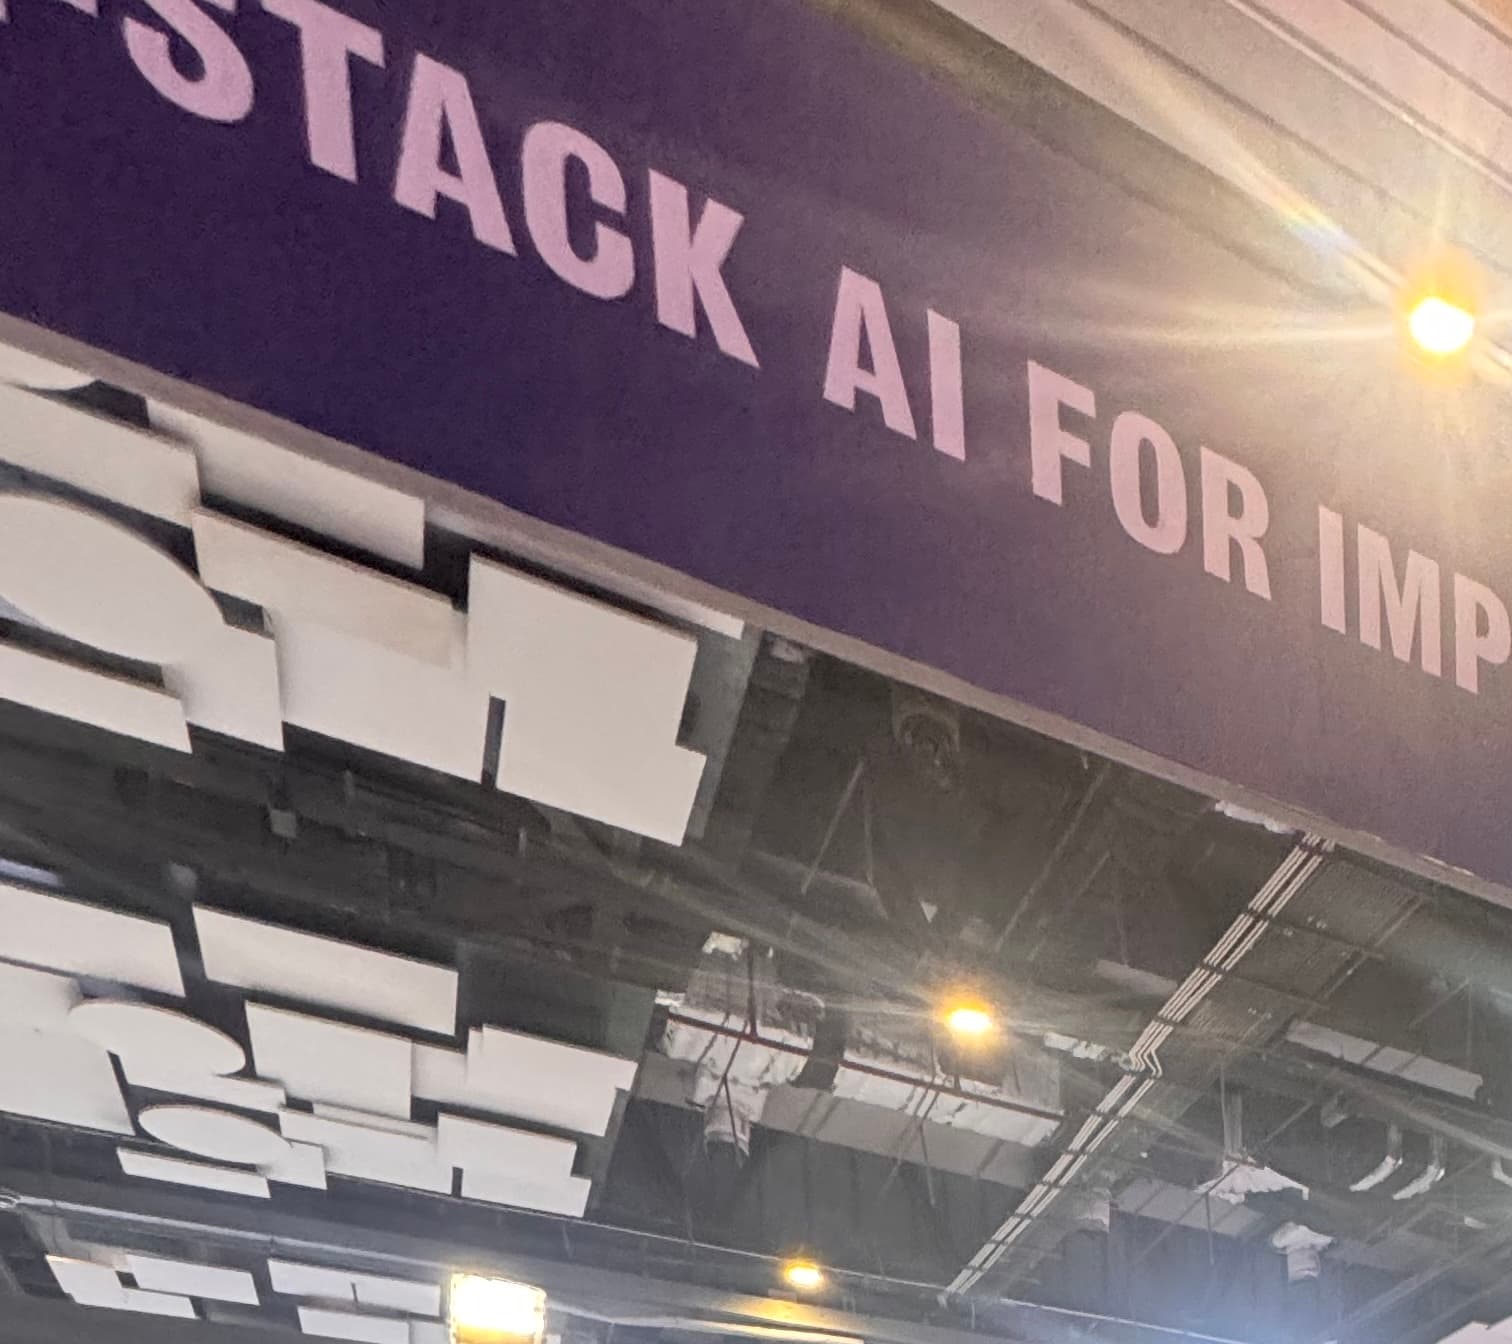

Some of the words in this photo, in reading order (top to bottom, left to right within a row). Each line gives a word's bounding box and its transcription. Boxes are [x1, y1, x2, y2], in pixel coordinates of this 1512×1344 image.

[122, 0, 760, 368] STACK
[823, 266, 966, 462] AI
[1027, 360, 1272, 600] FOR
